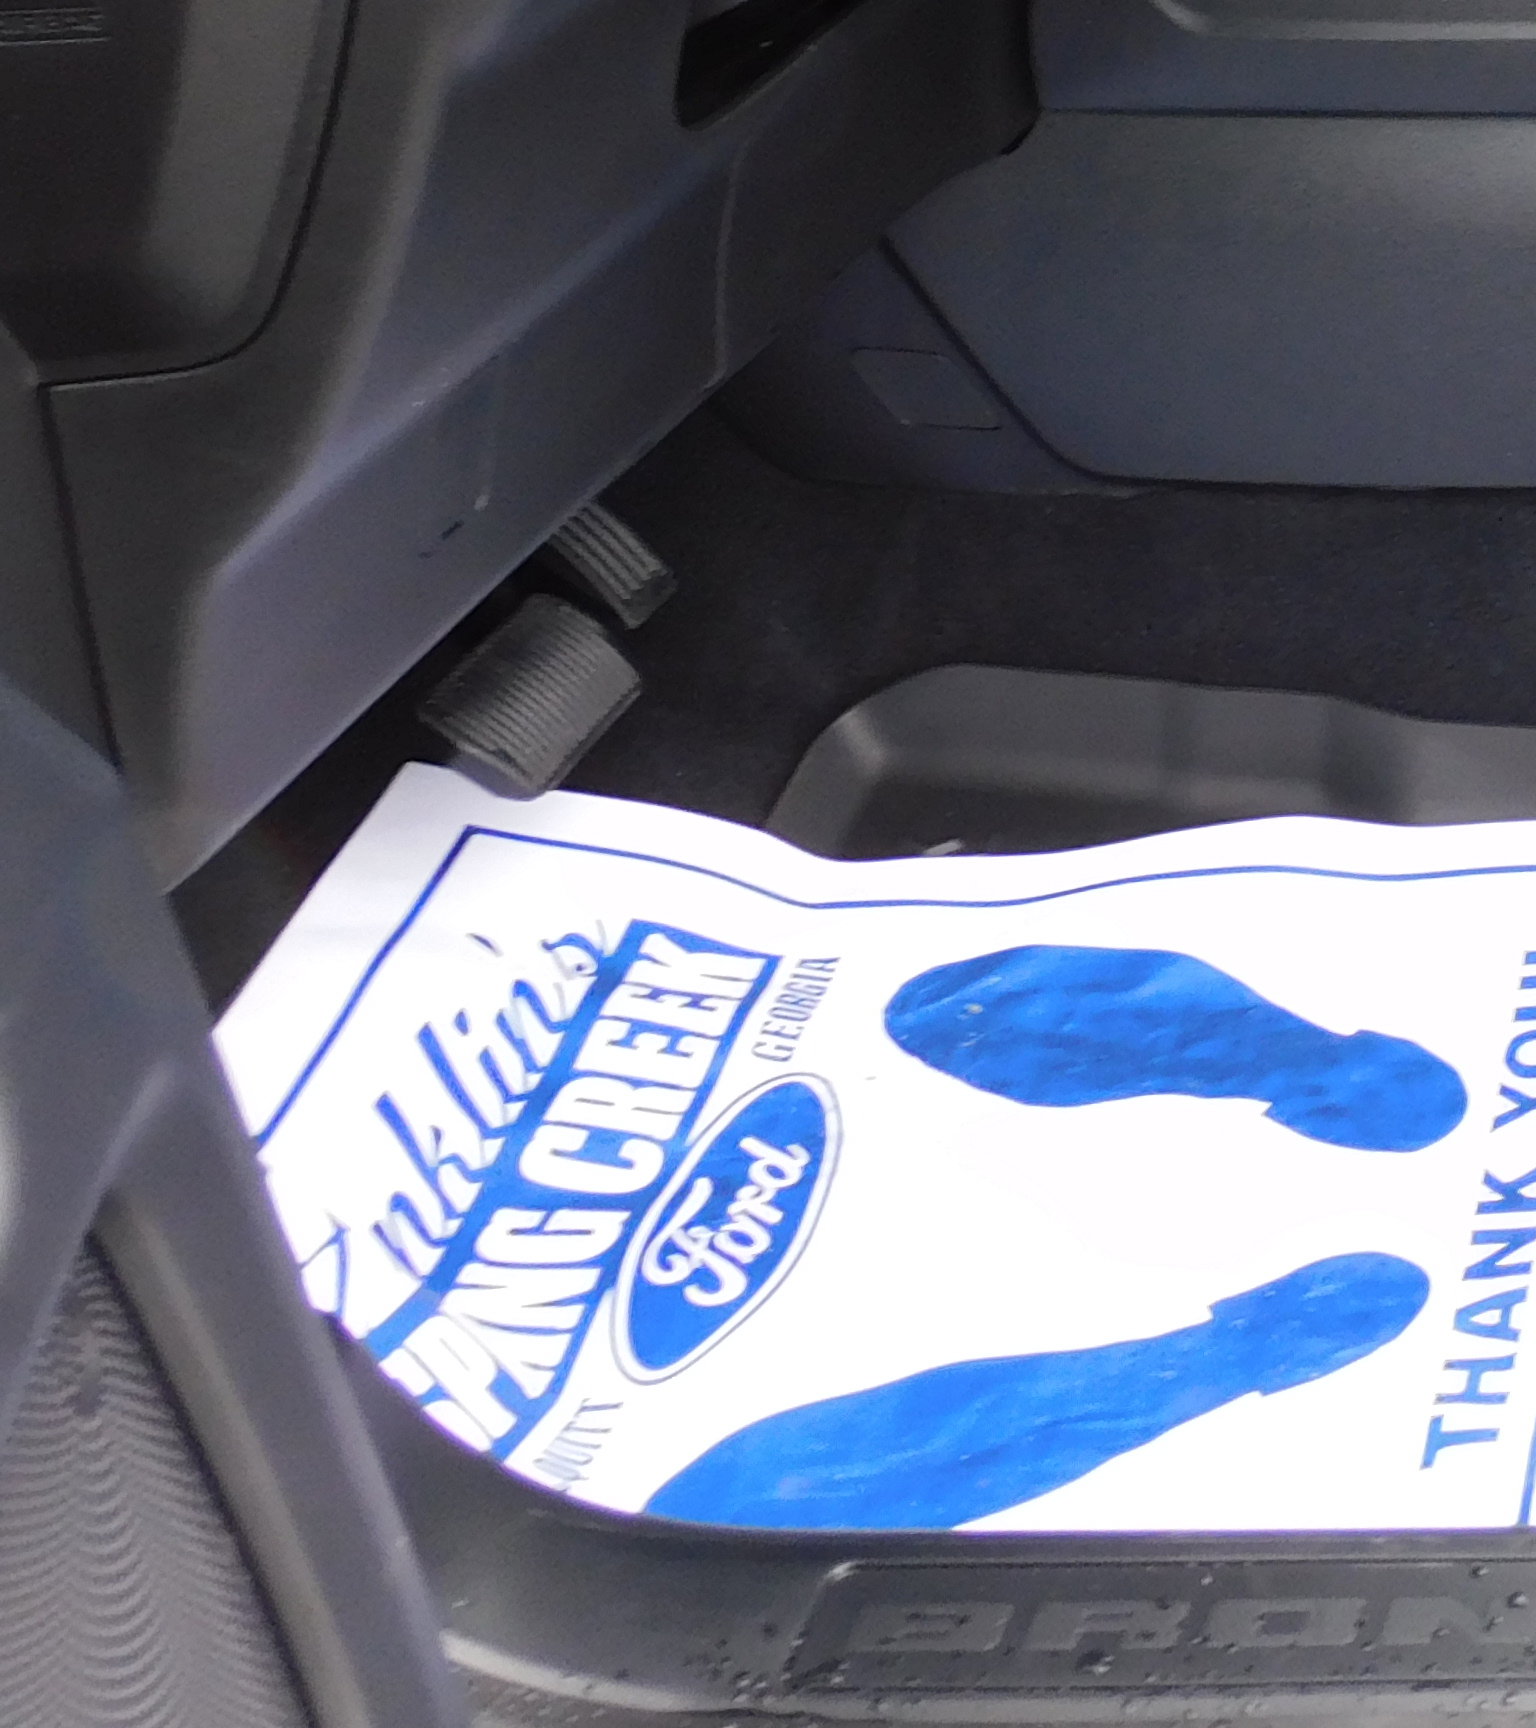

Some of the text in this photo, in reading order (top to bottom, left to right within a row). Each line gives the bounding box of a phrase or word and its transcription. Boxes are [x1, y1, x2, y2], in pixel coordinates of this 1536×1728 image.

[518, 933, 767, 1195] CREEK
[751, 957, 841, 1062] GEORGIA
[641, 1136, 811, 1307] Ford
